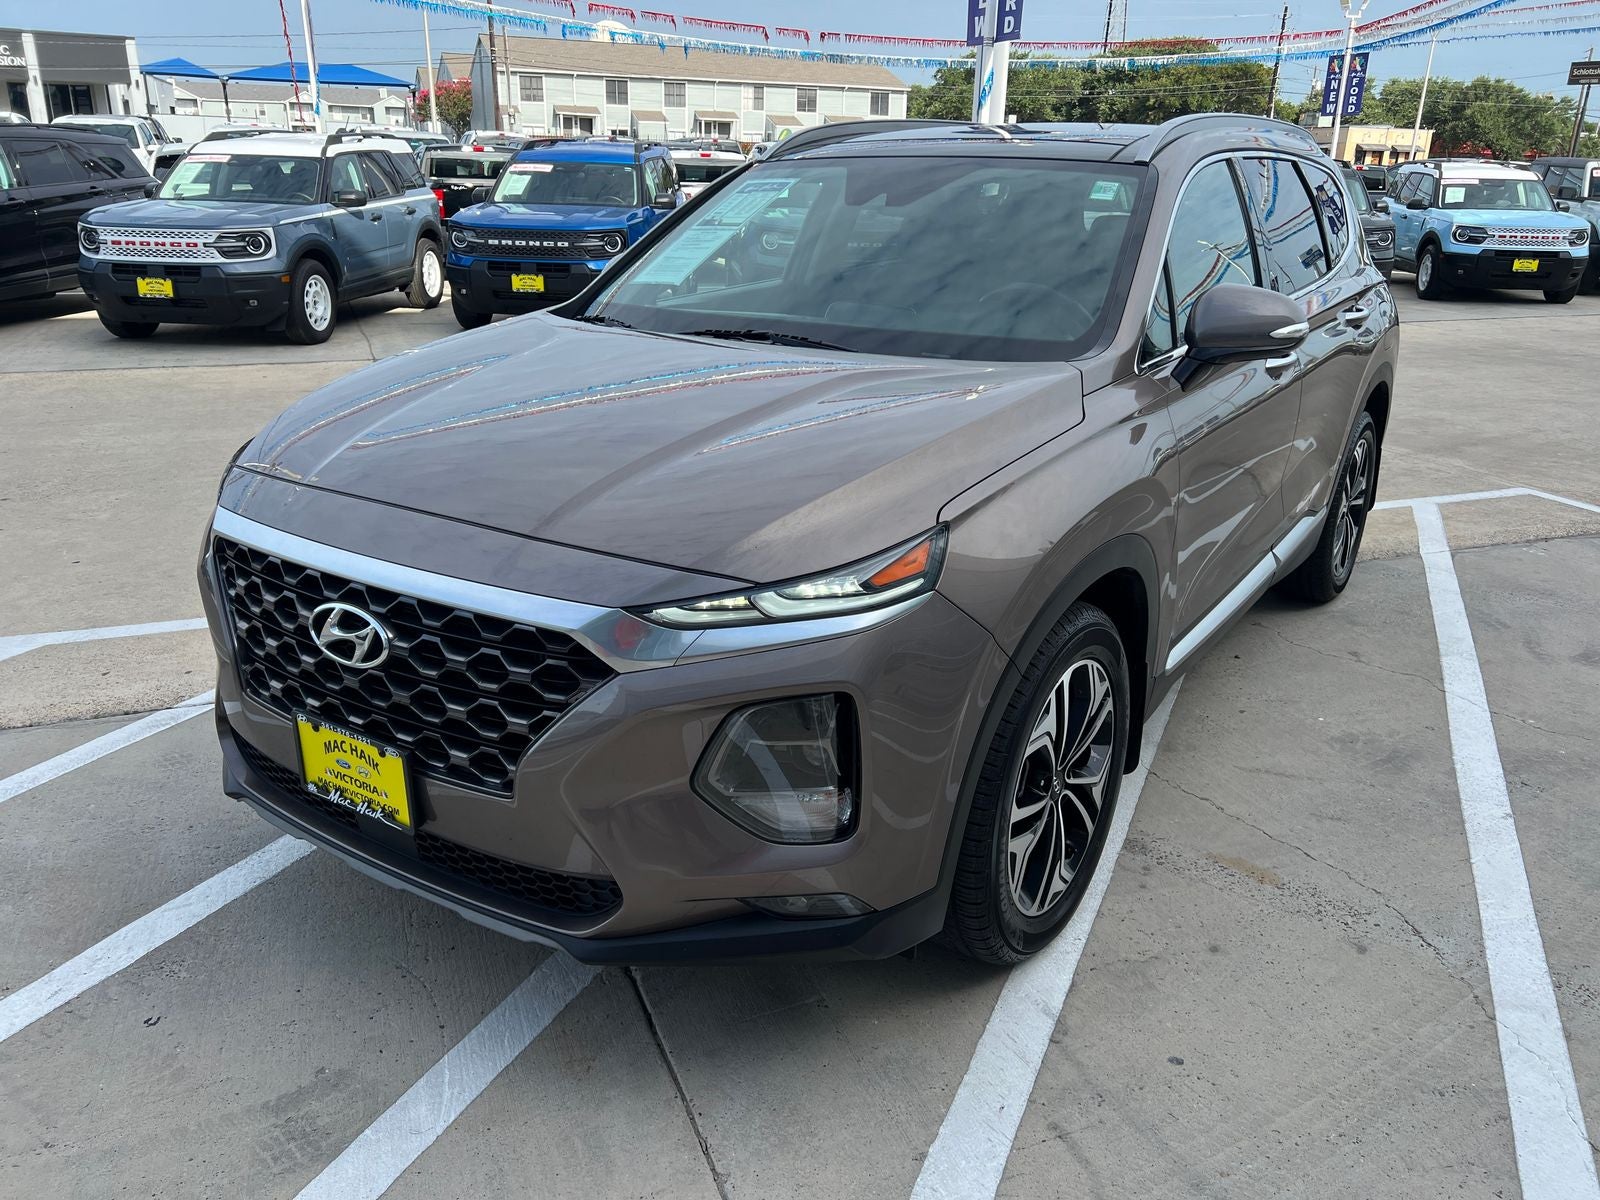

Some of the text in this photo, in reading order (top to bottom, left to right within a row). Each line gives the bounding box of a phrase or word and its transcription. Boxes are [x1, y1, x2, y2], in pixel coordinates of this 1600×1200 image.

[1326, 80, 1339, 114] NEW
[1347, 77, 1360, 113] FORD
[111, 240, 198, 248] BRONCO
[488, 239, 569, 247] BRONCO
[323, 739, 347, 755] MAC
[349, 742, 381, 776] HAIK
[317, 776, 400, 816] MACHAIKVICTORIA.COM
[331, 768, 380, 797] VICTORIA
[328, 789, 384, 819] Mac Haik
